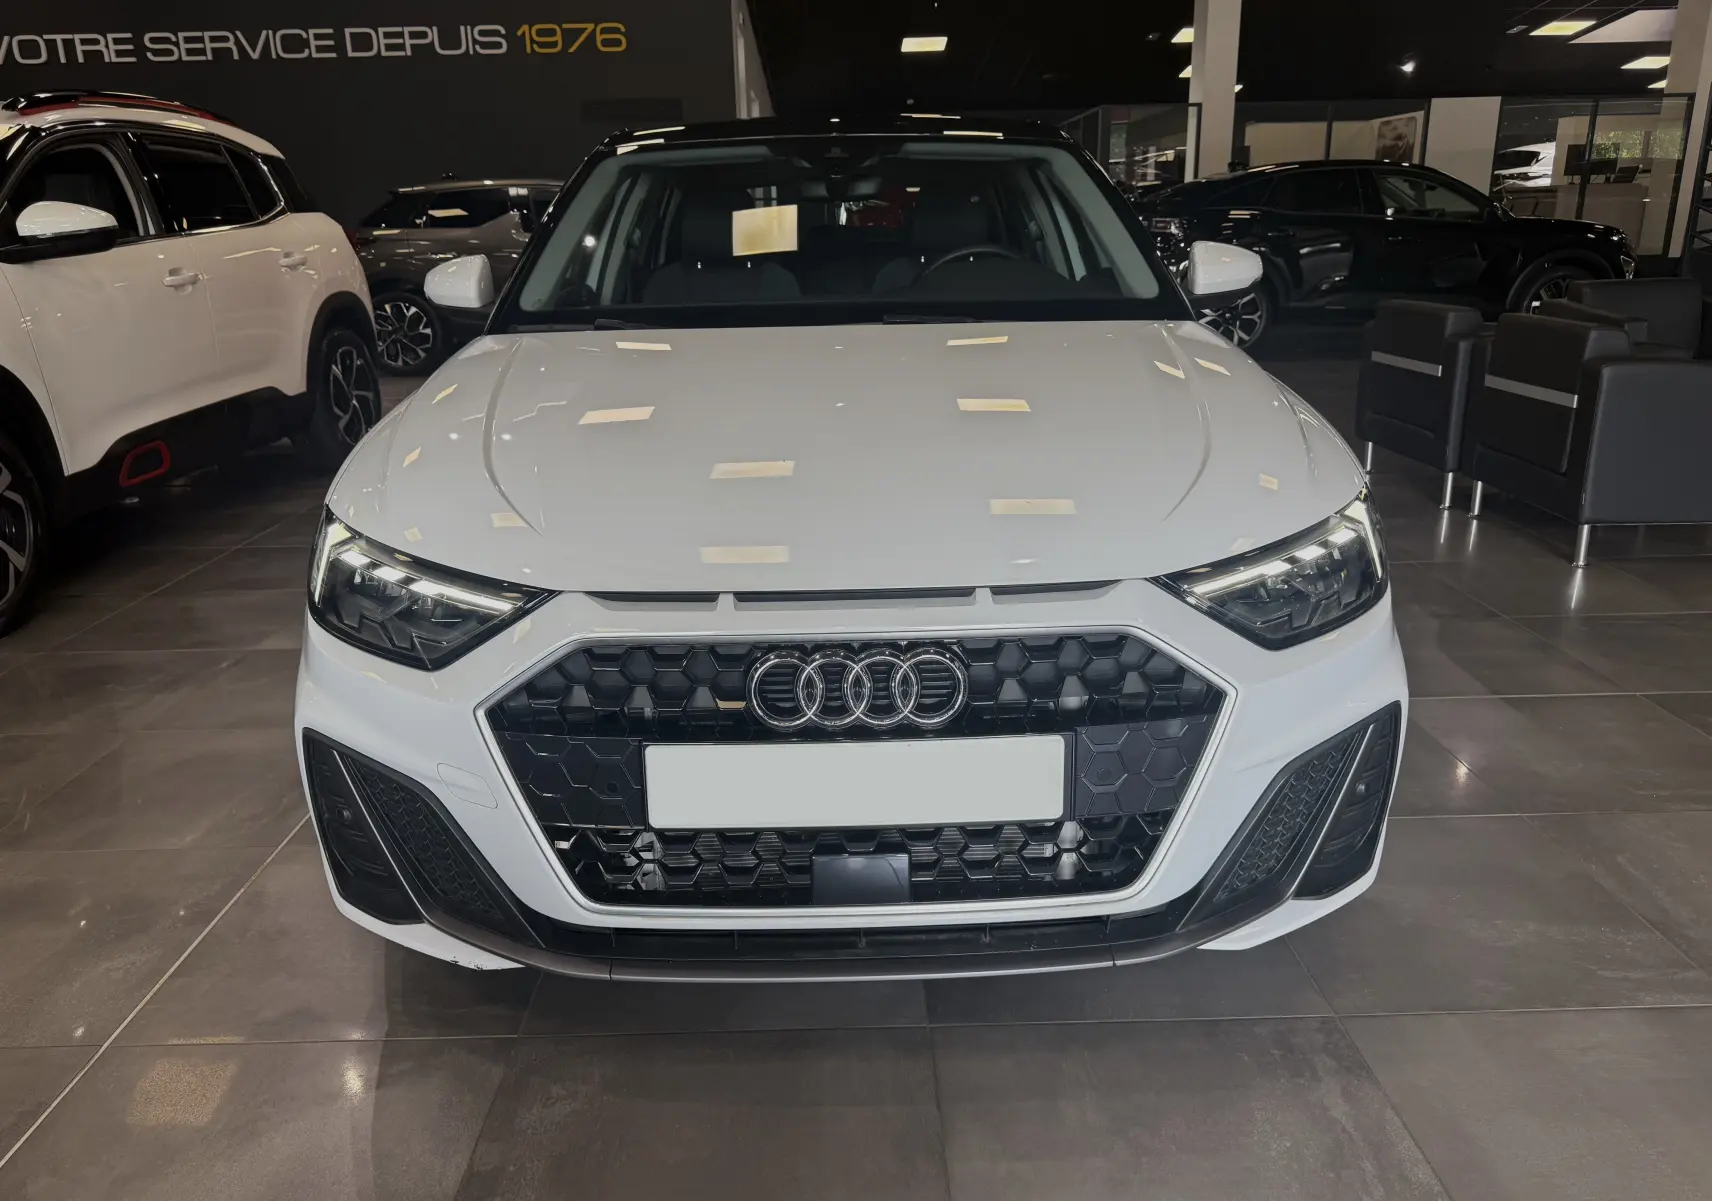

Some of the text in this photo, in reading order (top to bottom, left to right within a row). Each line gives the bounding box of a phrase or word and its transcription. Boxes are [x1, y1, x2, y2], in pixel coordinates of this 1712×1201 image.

[143, 28, 338, 62] SERVICE
[344, 24, 508, 57] DEPUIS
[516, 22, 627, 54] 1976
